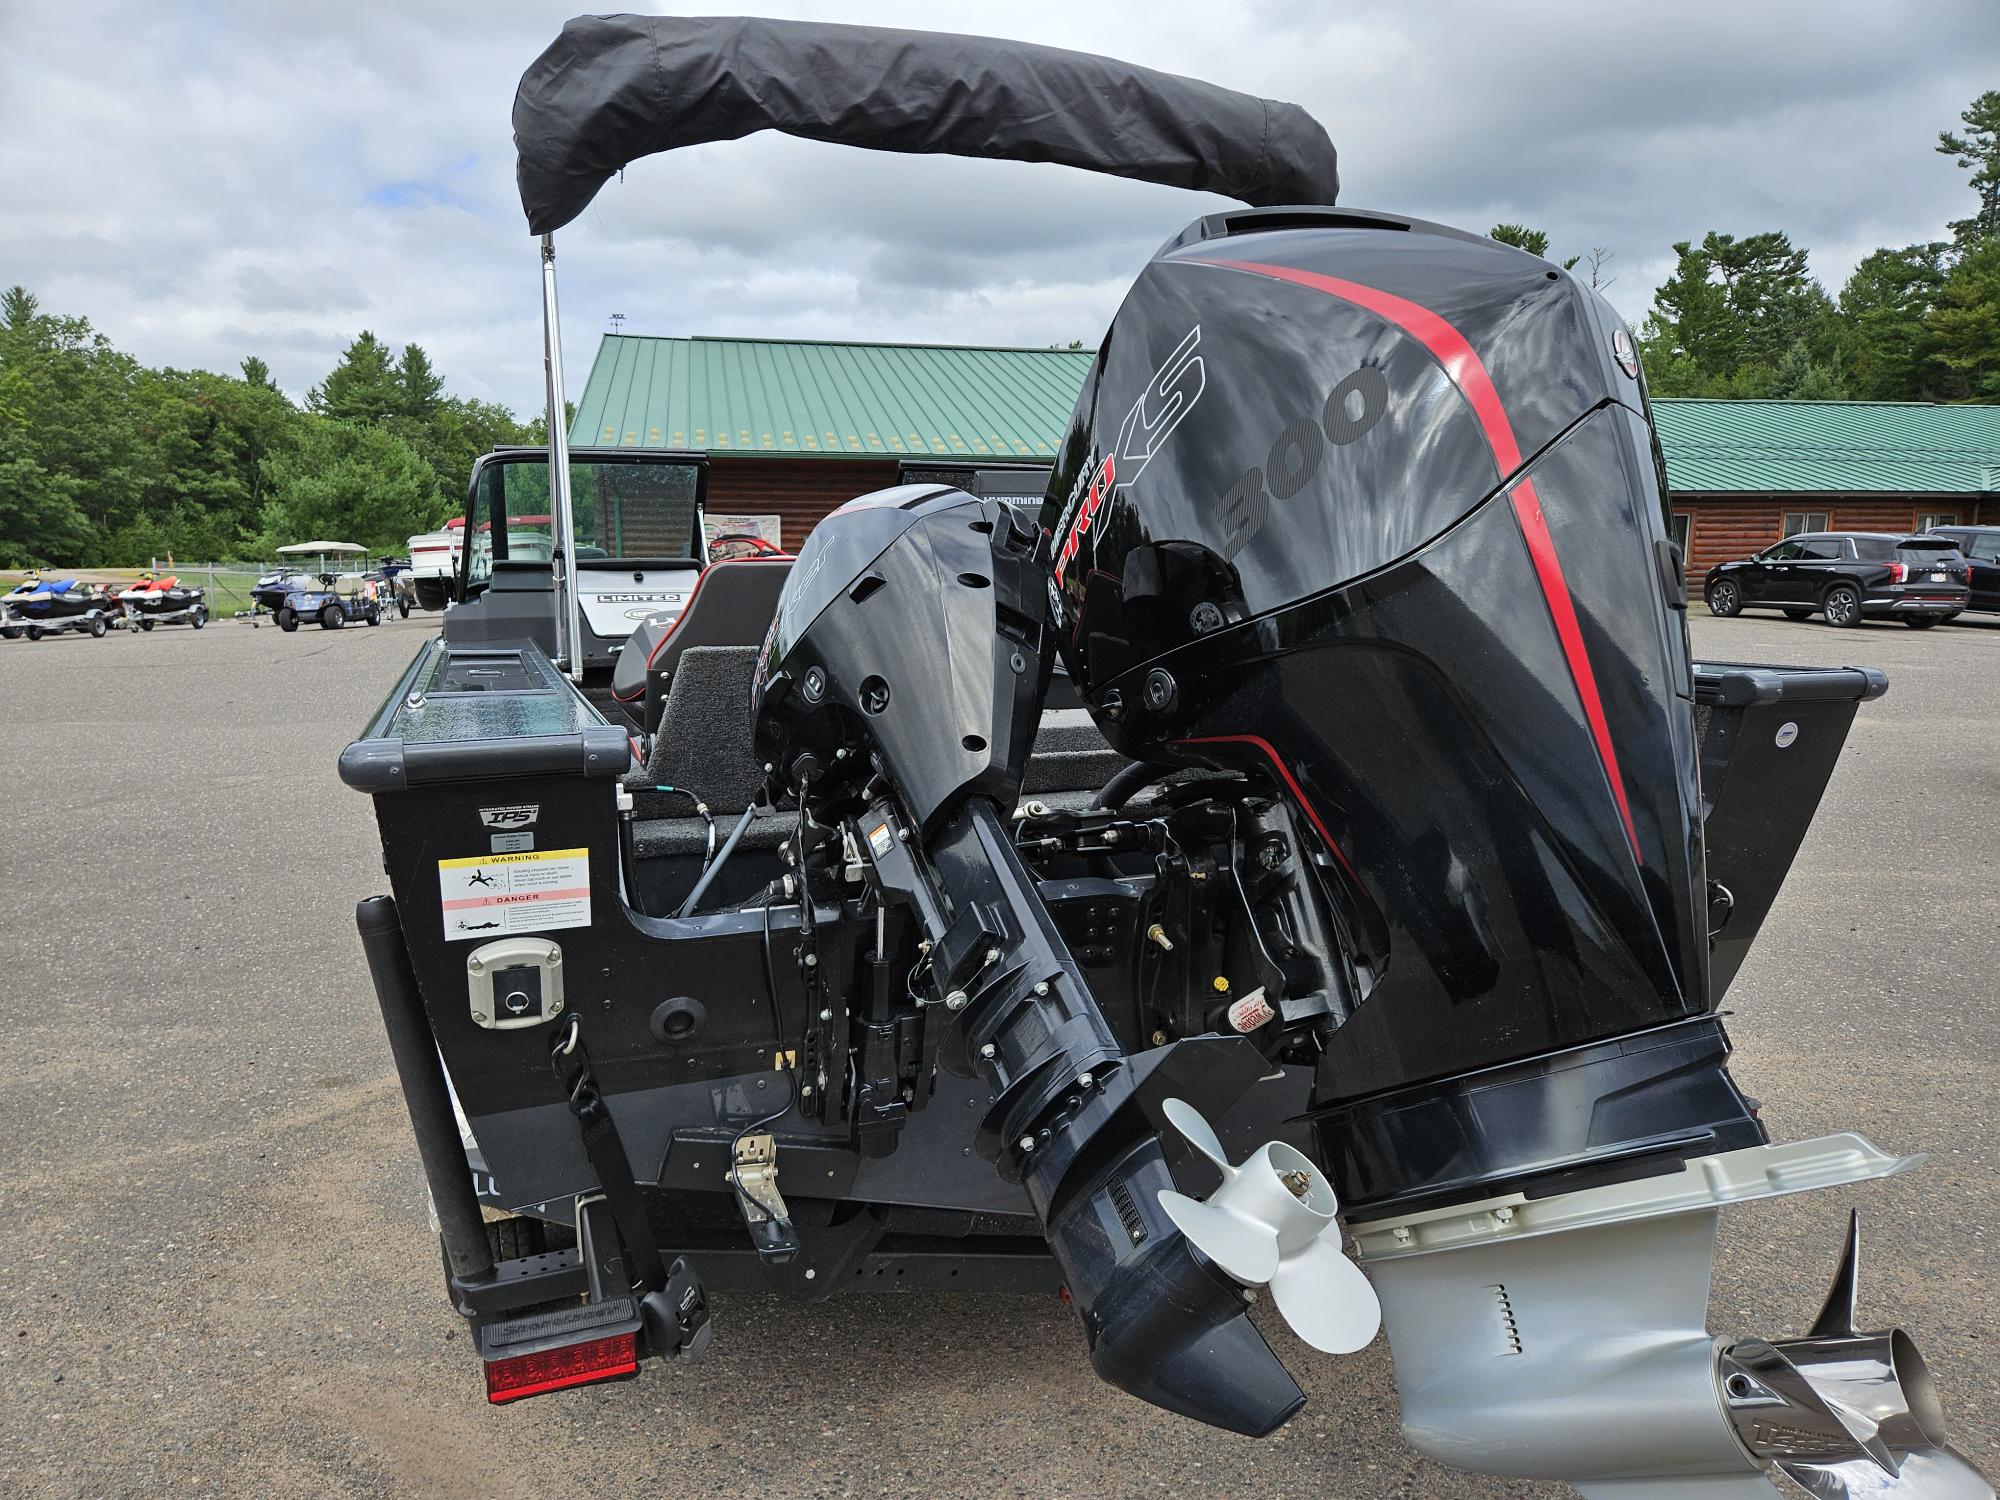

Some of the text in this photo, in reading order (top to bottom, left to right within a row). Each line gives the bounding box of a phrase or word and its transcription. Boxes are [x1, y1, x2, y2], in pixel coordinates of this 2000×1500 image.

[1215, 367, 1389, 564] 300
[1051, 445, 1098, 560] MERCURY
[1055, 453, 1116, 590] PRO
[487, 810, 531, 824] IPS
[491, 854, 540, 863] WARNING
[496, 894, 540, 904] DANGER
